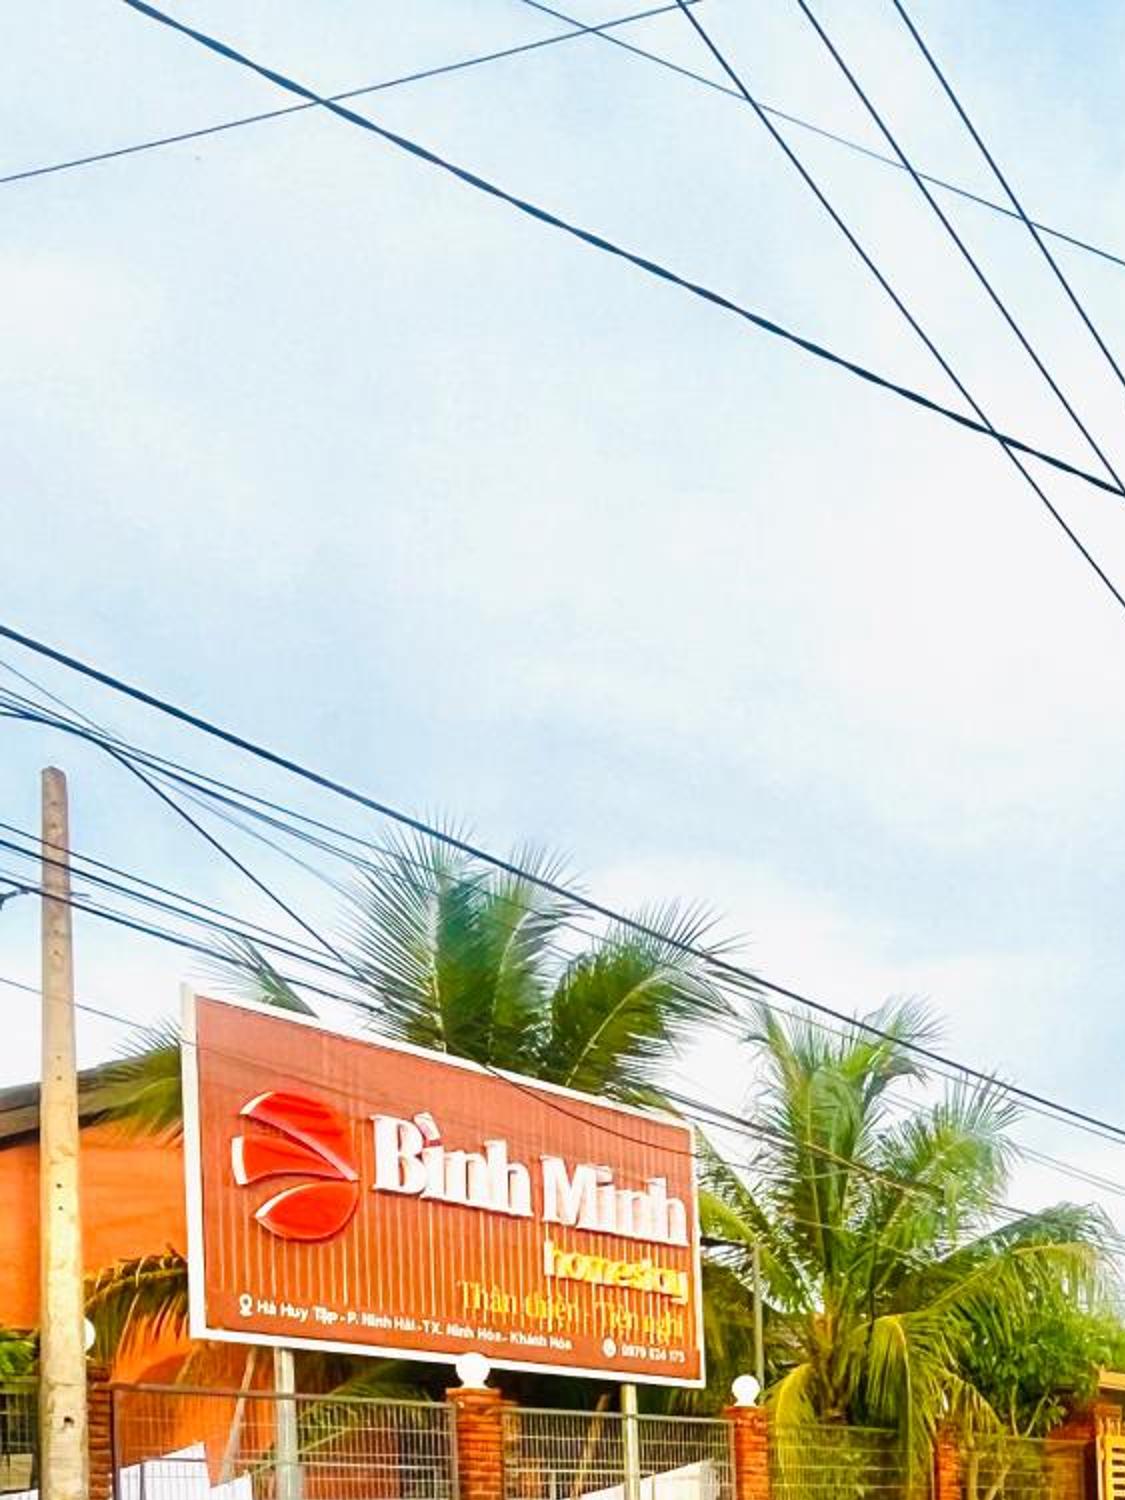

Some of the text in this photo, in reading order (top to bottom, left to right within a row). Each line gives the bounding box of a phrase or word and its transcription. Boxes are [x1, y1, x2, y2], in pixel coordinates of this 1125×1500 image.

[370, 1112, 690, 1247] Bình Minh
[543, 1239, 689, 1306] homestay
[280, 1302, 308, 1323] Huy
